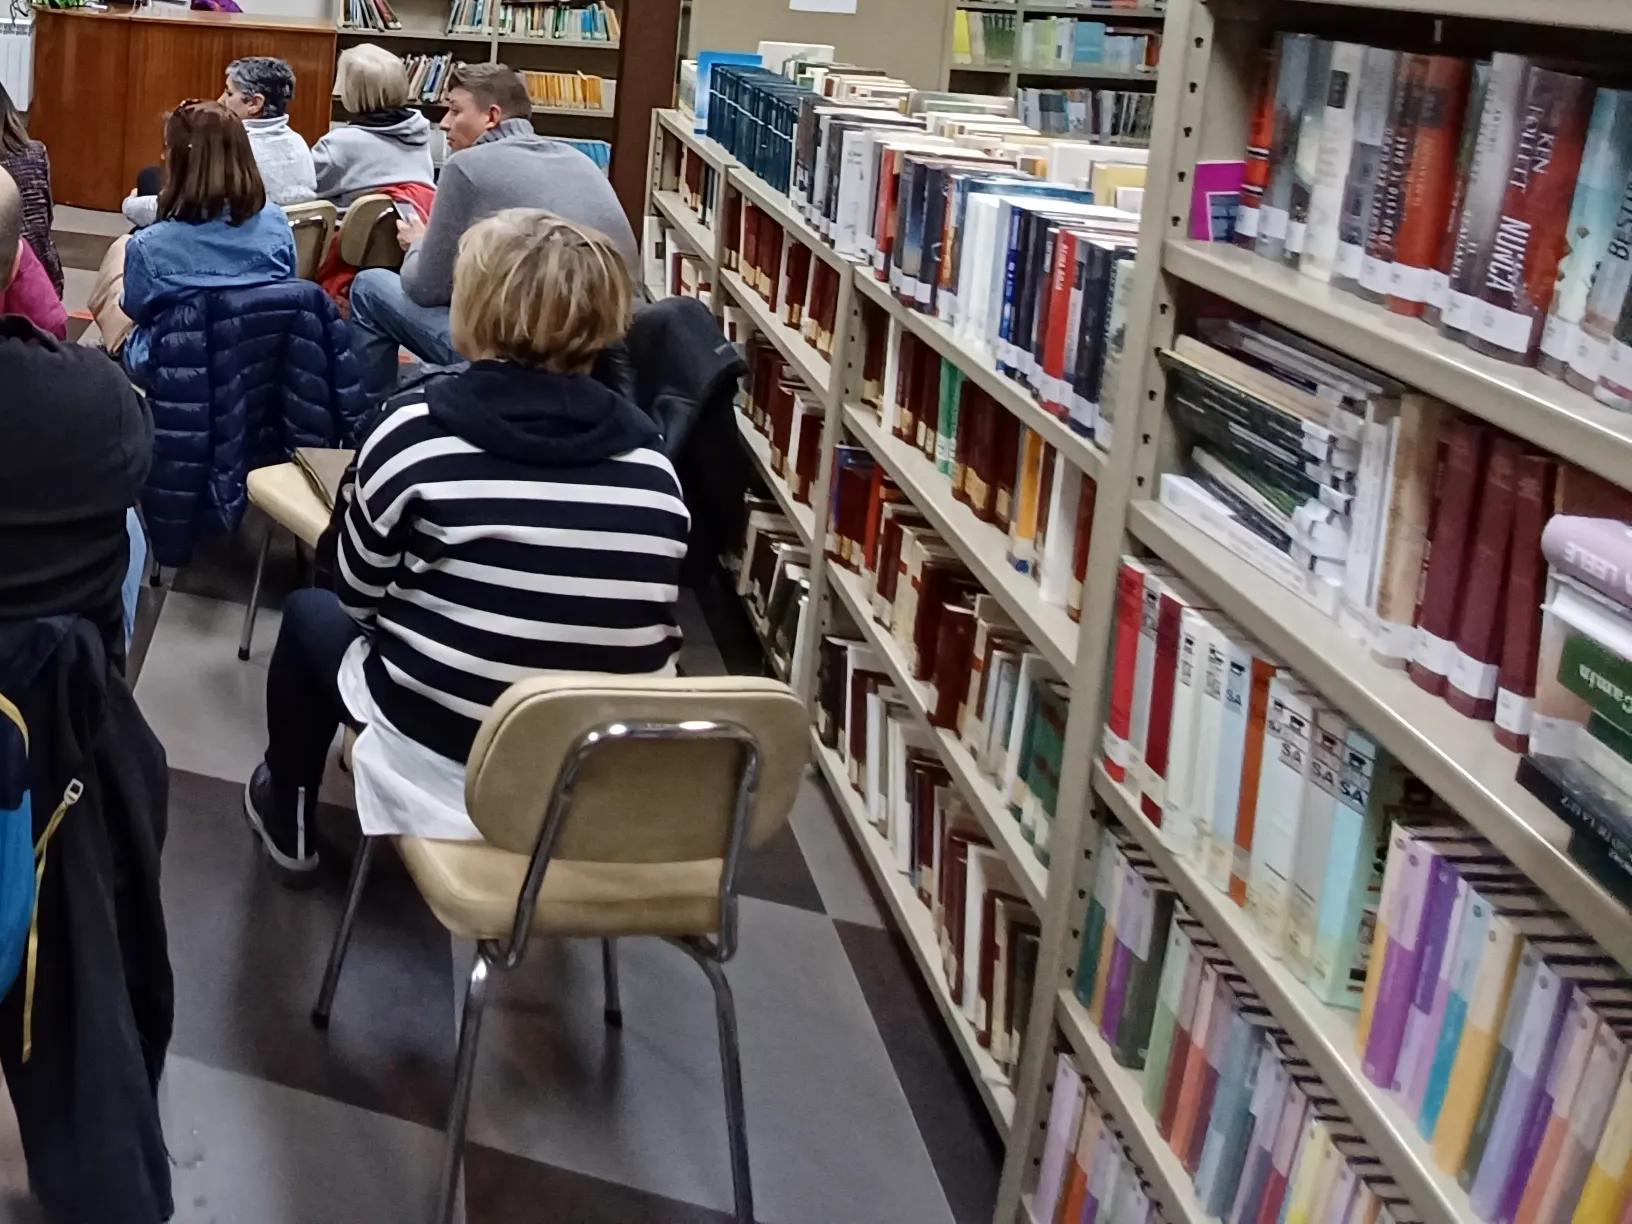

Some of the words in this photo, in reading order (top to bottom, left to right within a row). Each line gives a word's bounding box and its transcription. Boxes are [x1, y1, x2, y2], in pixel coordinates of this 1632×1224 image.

[1532, 131, 1556, 175] KEN
[1485, 214, 1532, 293] NUNCA
[1281, 742, 1302, 765] SA
[1311, 761, 1335, 787] SA
[1339, 780, 1365, 807] SA
